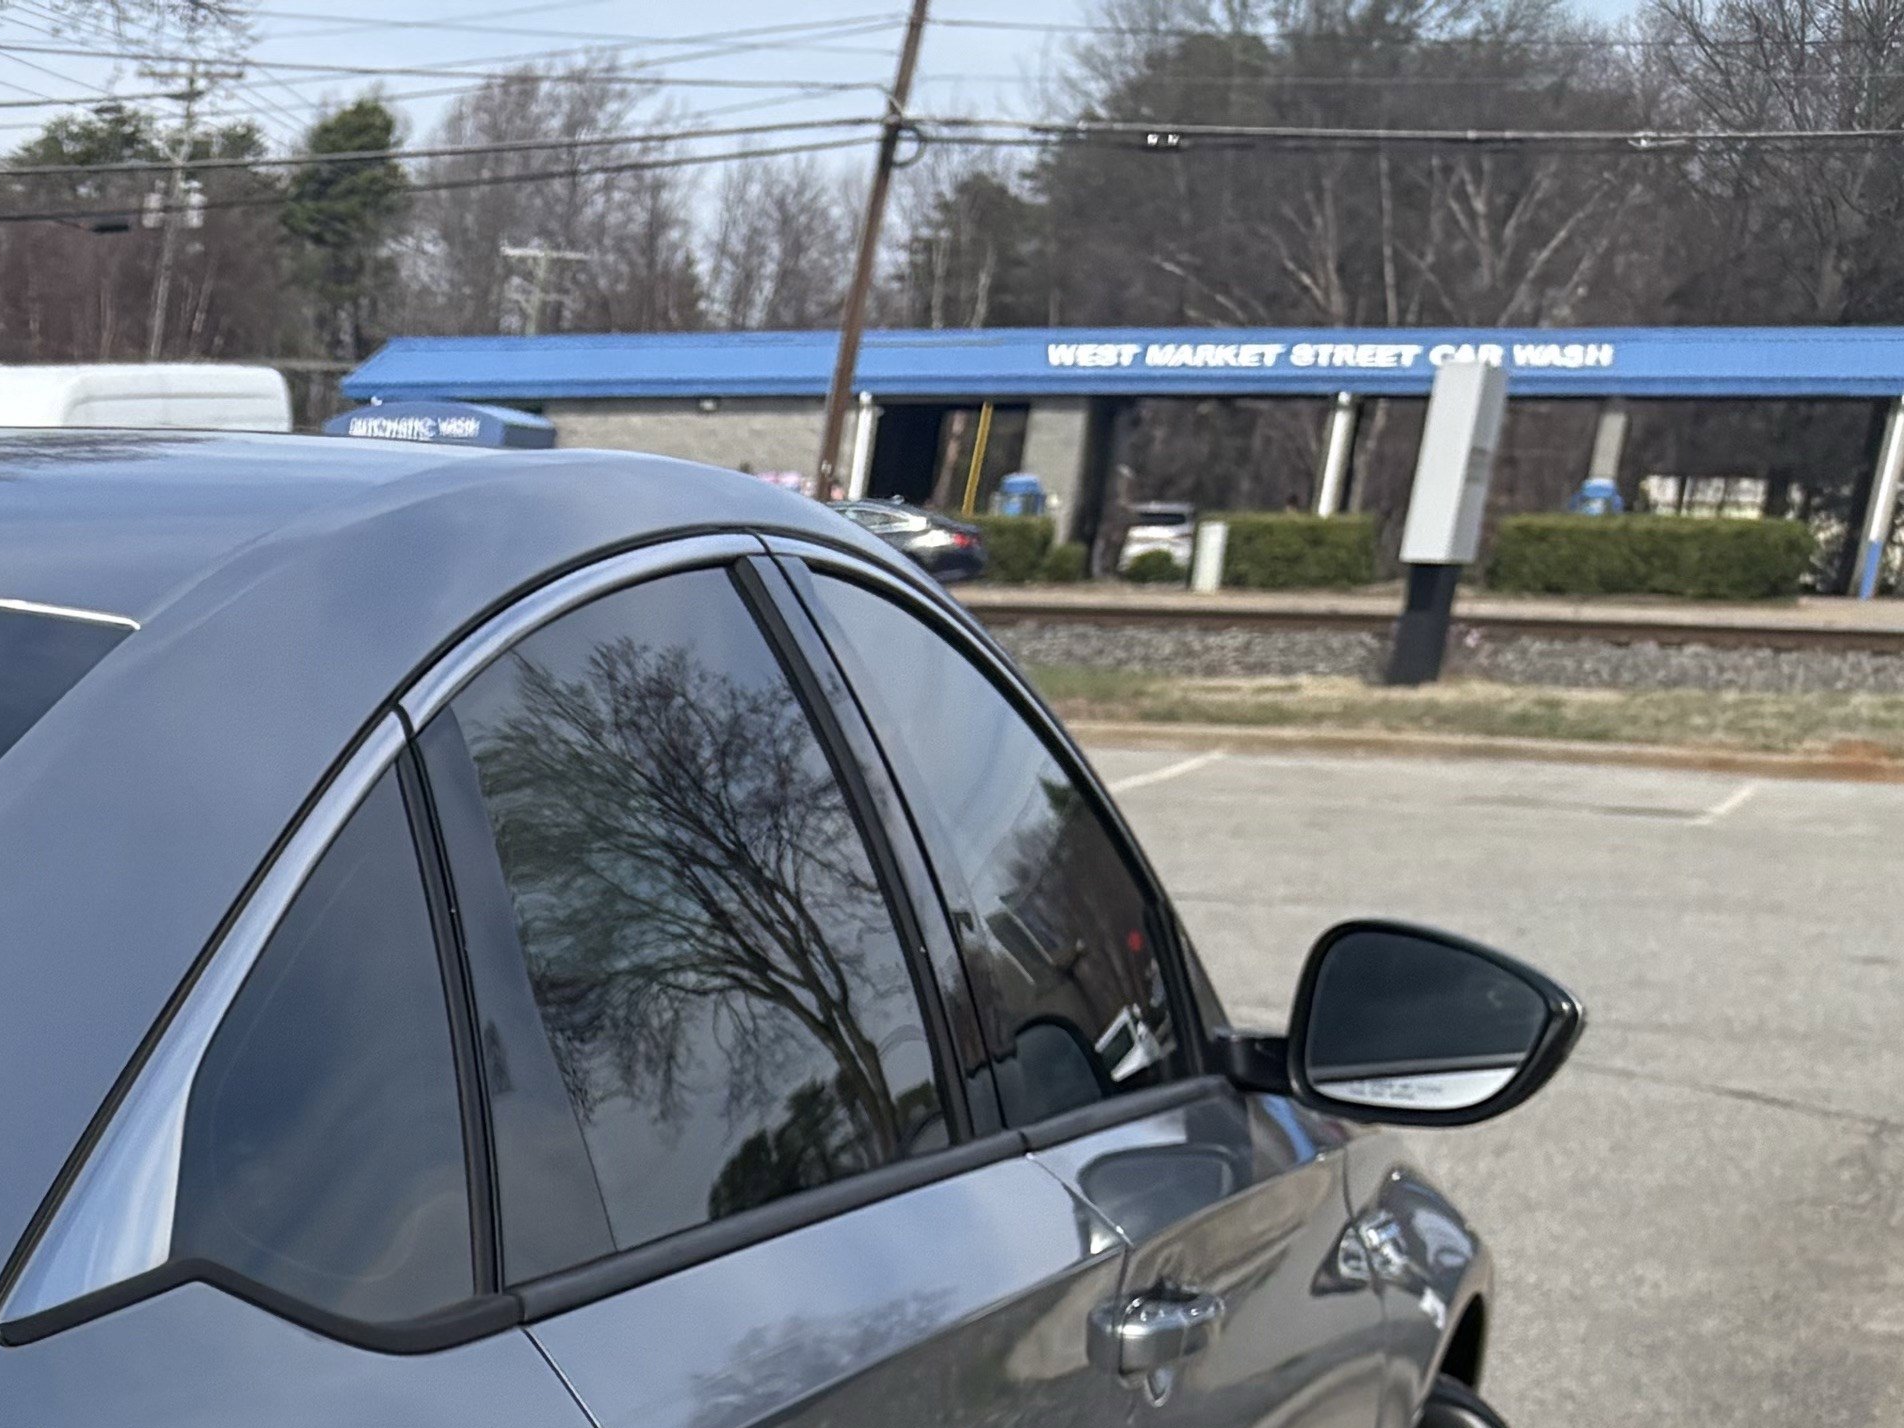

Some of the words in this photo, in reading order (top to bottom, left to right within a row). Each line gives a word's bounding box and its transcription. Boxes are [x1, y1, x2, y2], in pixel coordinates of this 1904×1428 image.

[1048, 343, 1141, 367] WEST
[1145, 343, 1284, 367] MARKET
[1290, 342, 1424, 368] STREET
[1428, 343, 1504, 367] CAR
[1513, 343, 1614, 368] WASH
